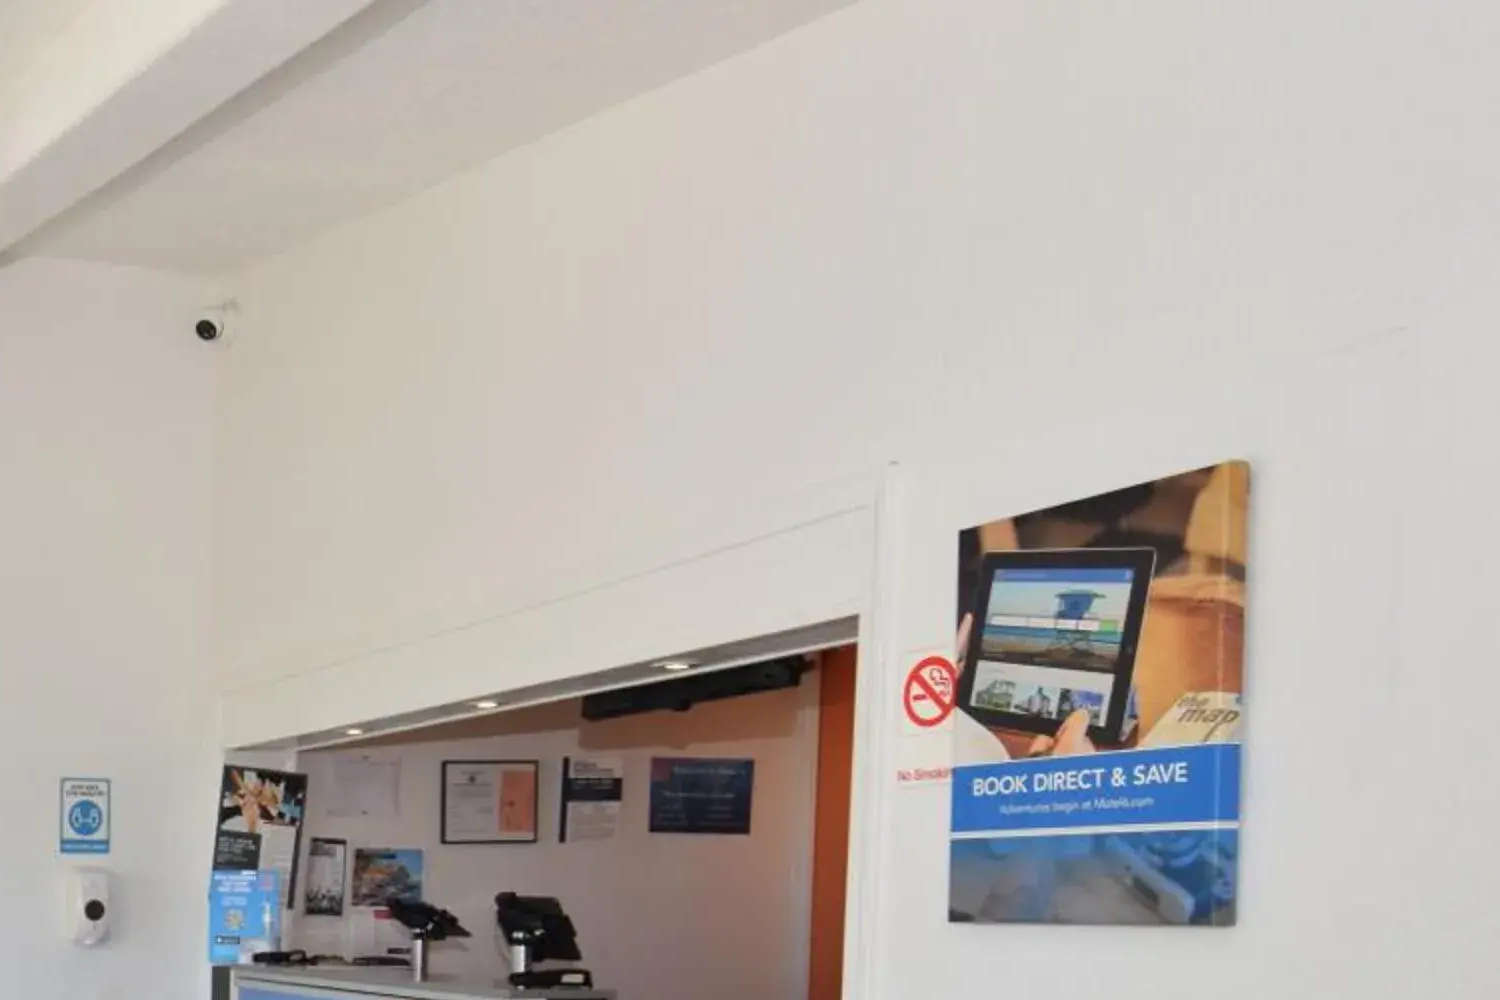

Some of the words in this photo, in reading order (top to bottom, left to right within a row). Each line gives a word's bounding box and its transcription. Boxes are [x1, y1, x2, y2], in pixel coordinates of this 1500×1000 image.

[1177, 708, 1240, 742] map
[972, 773, 1028, 797] BOOK
[1032, 768, 1105, 793] DIRECT
[1111, 766, 1127, 788] &
[1132, 761, 1189, 786] SAVE
